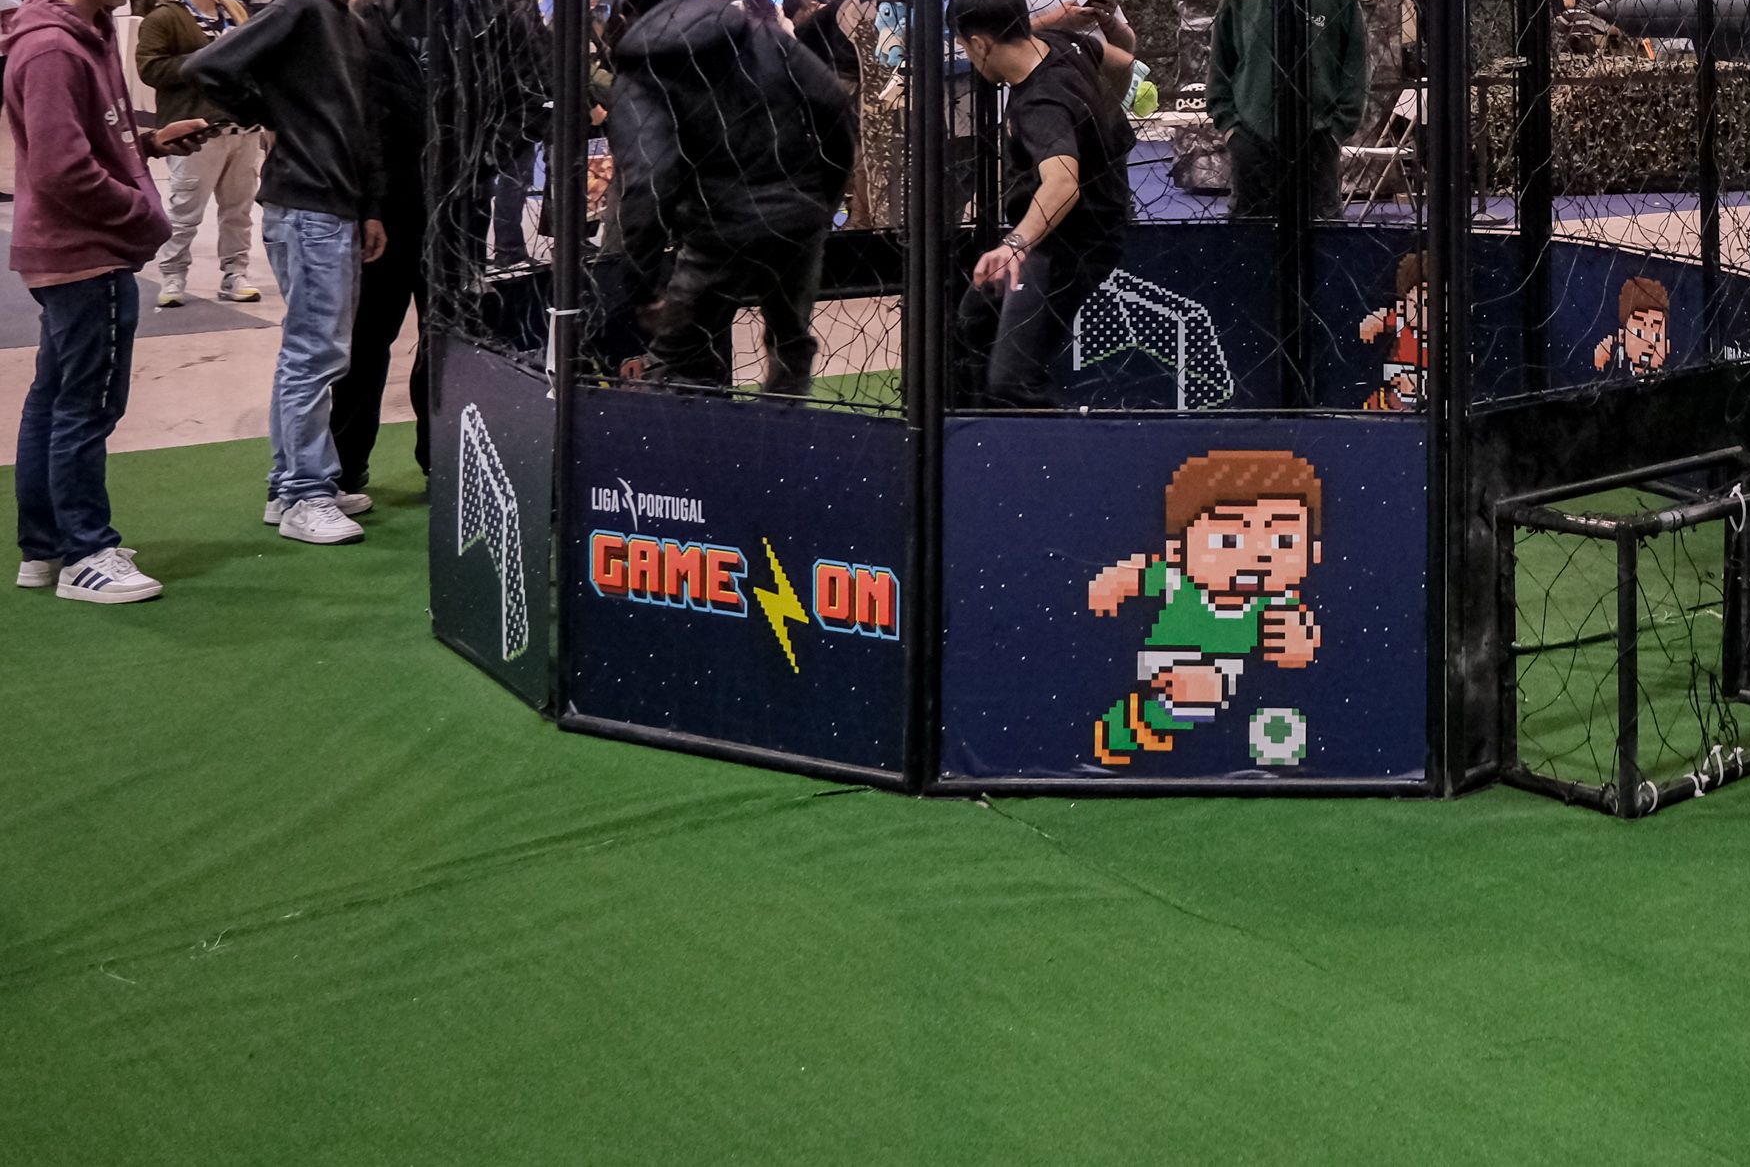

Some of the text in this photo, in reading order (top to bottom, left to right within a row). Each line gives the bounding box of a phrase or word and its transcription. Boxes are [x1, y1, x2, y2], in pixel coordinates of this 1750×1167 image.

[591, 486, 706, 524] LIGA PORTUGAL
[589, 529, 900, 641] GAME ON
